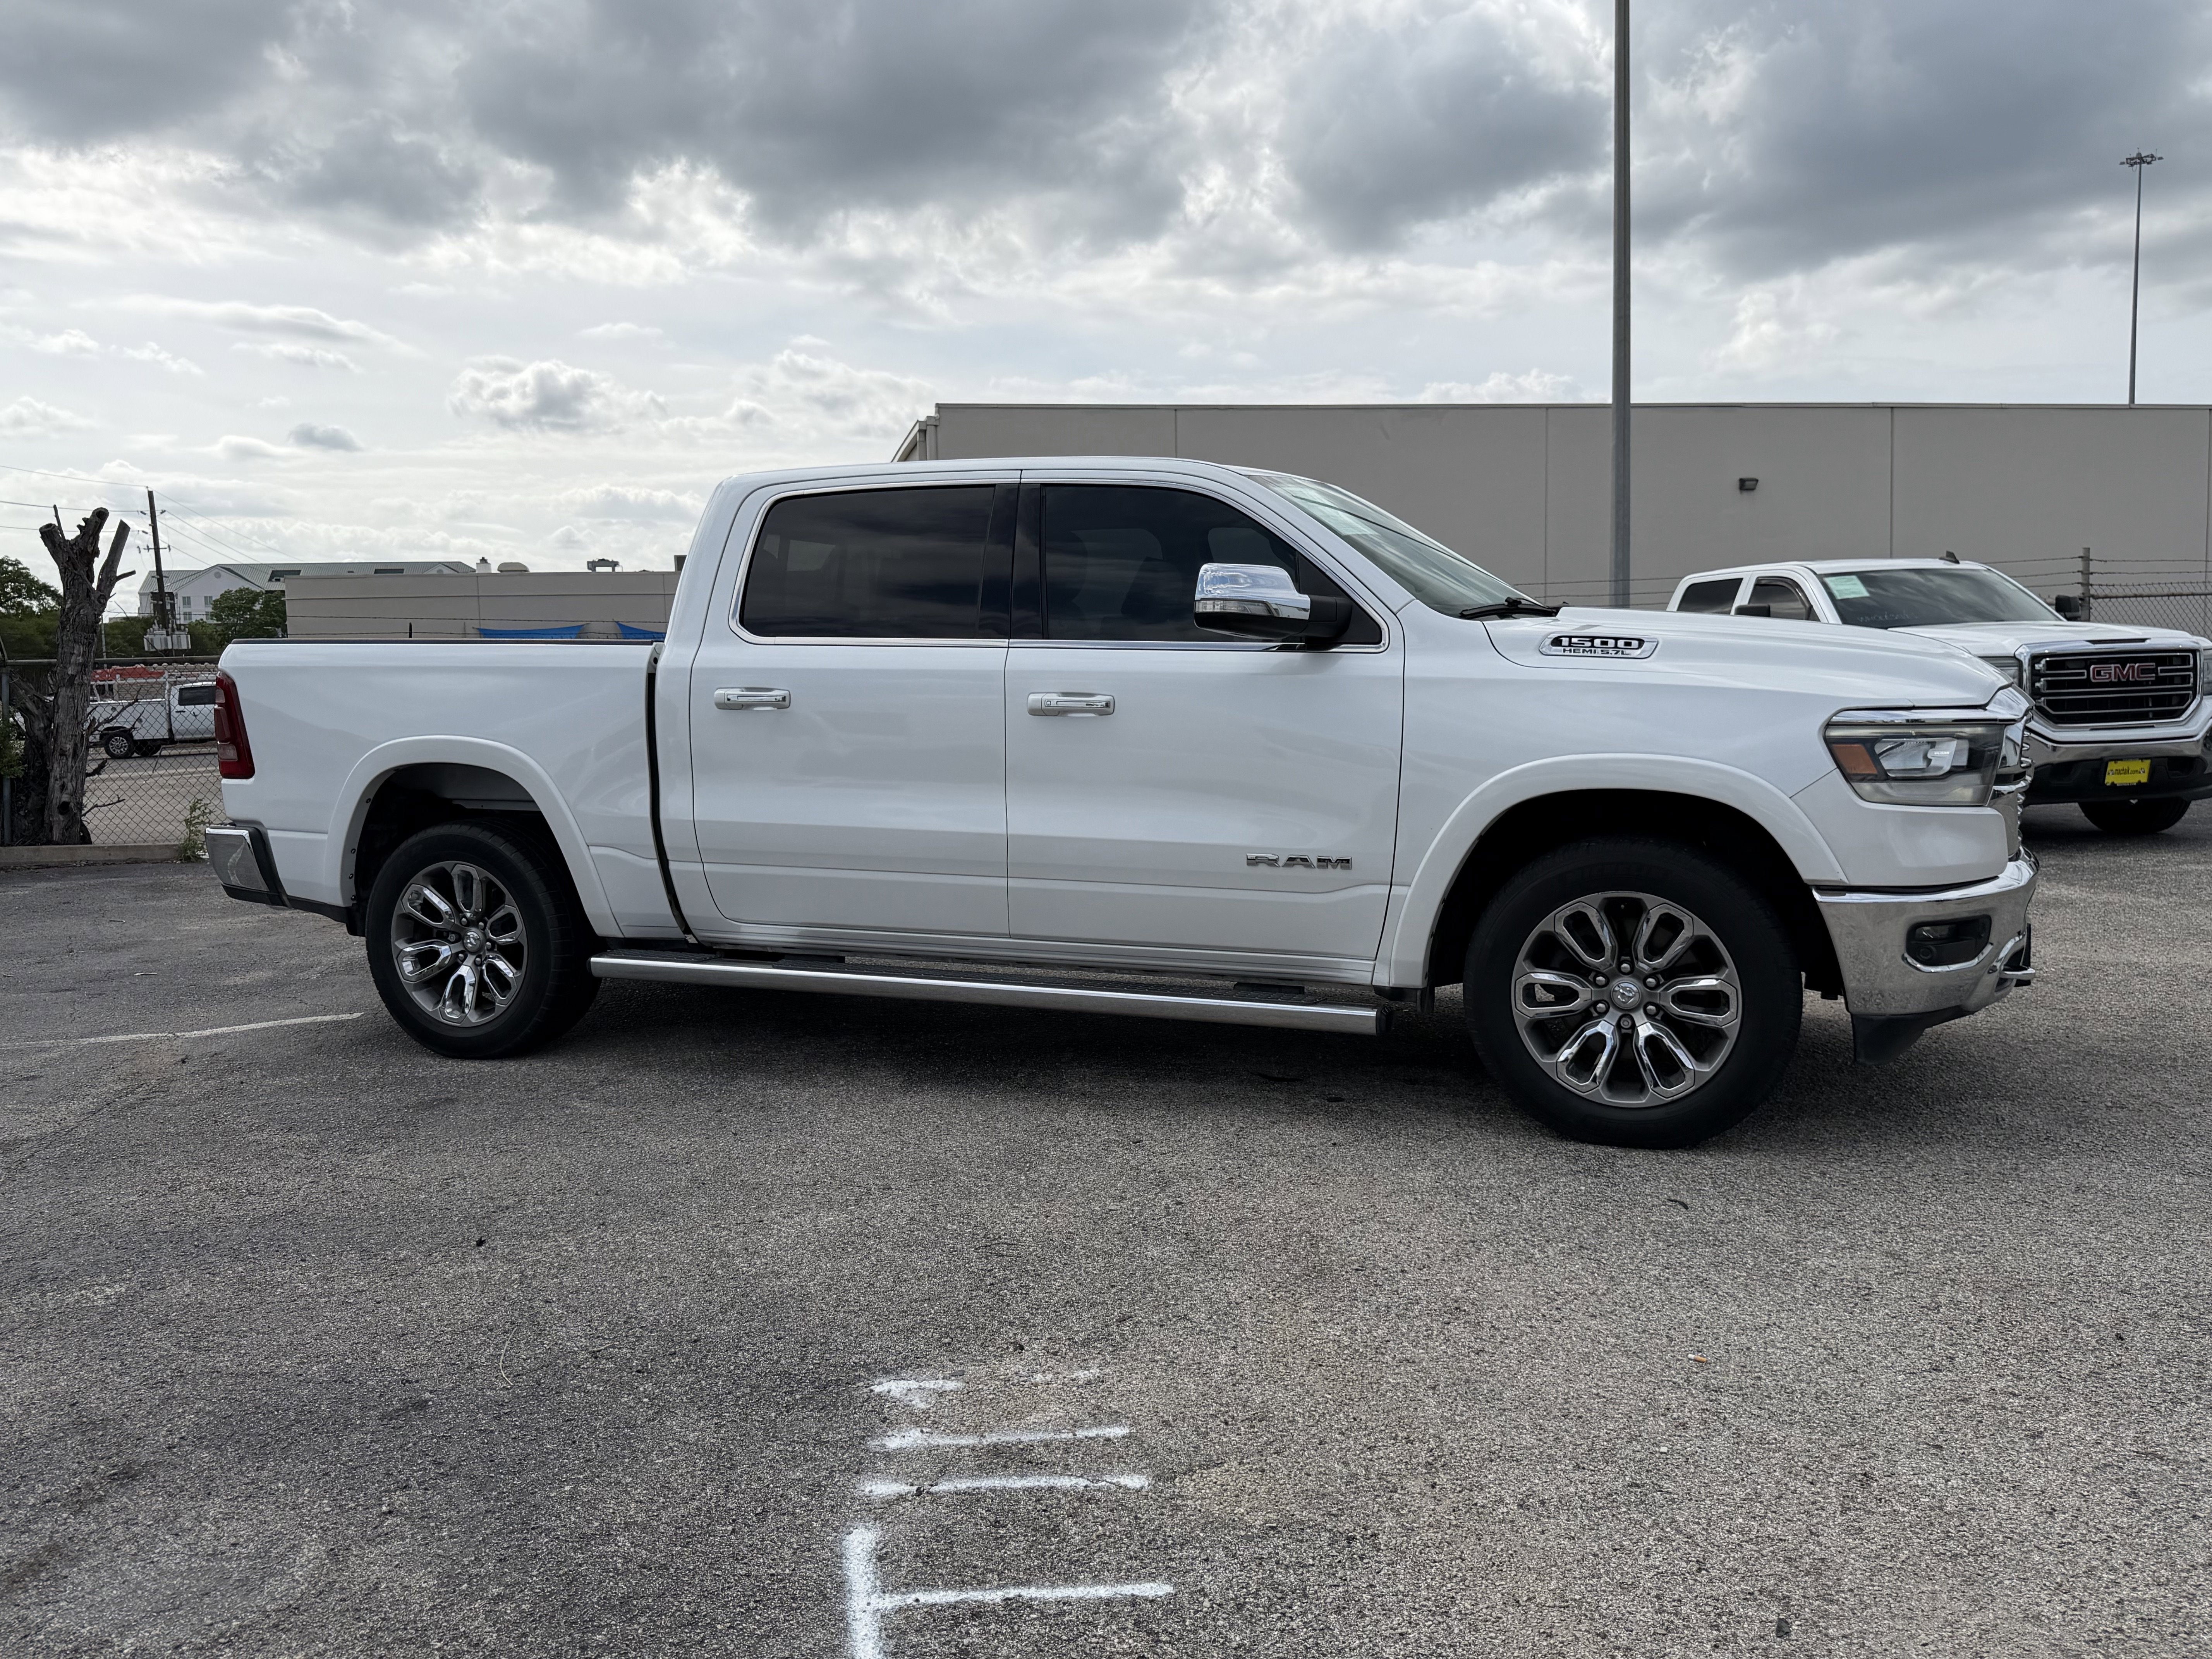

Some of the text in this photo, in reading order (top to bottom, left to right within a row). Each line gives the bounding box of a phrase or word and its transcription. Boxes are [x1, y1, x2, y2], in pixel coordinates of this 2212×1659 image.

[1558, 637, 1639, 649] 1500
[2090, 663, 2156, 682] GMC
[1246, 853, 1352, 870] RAM
